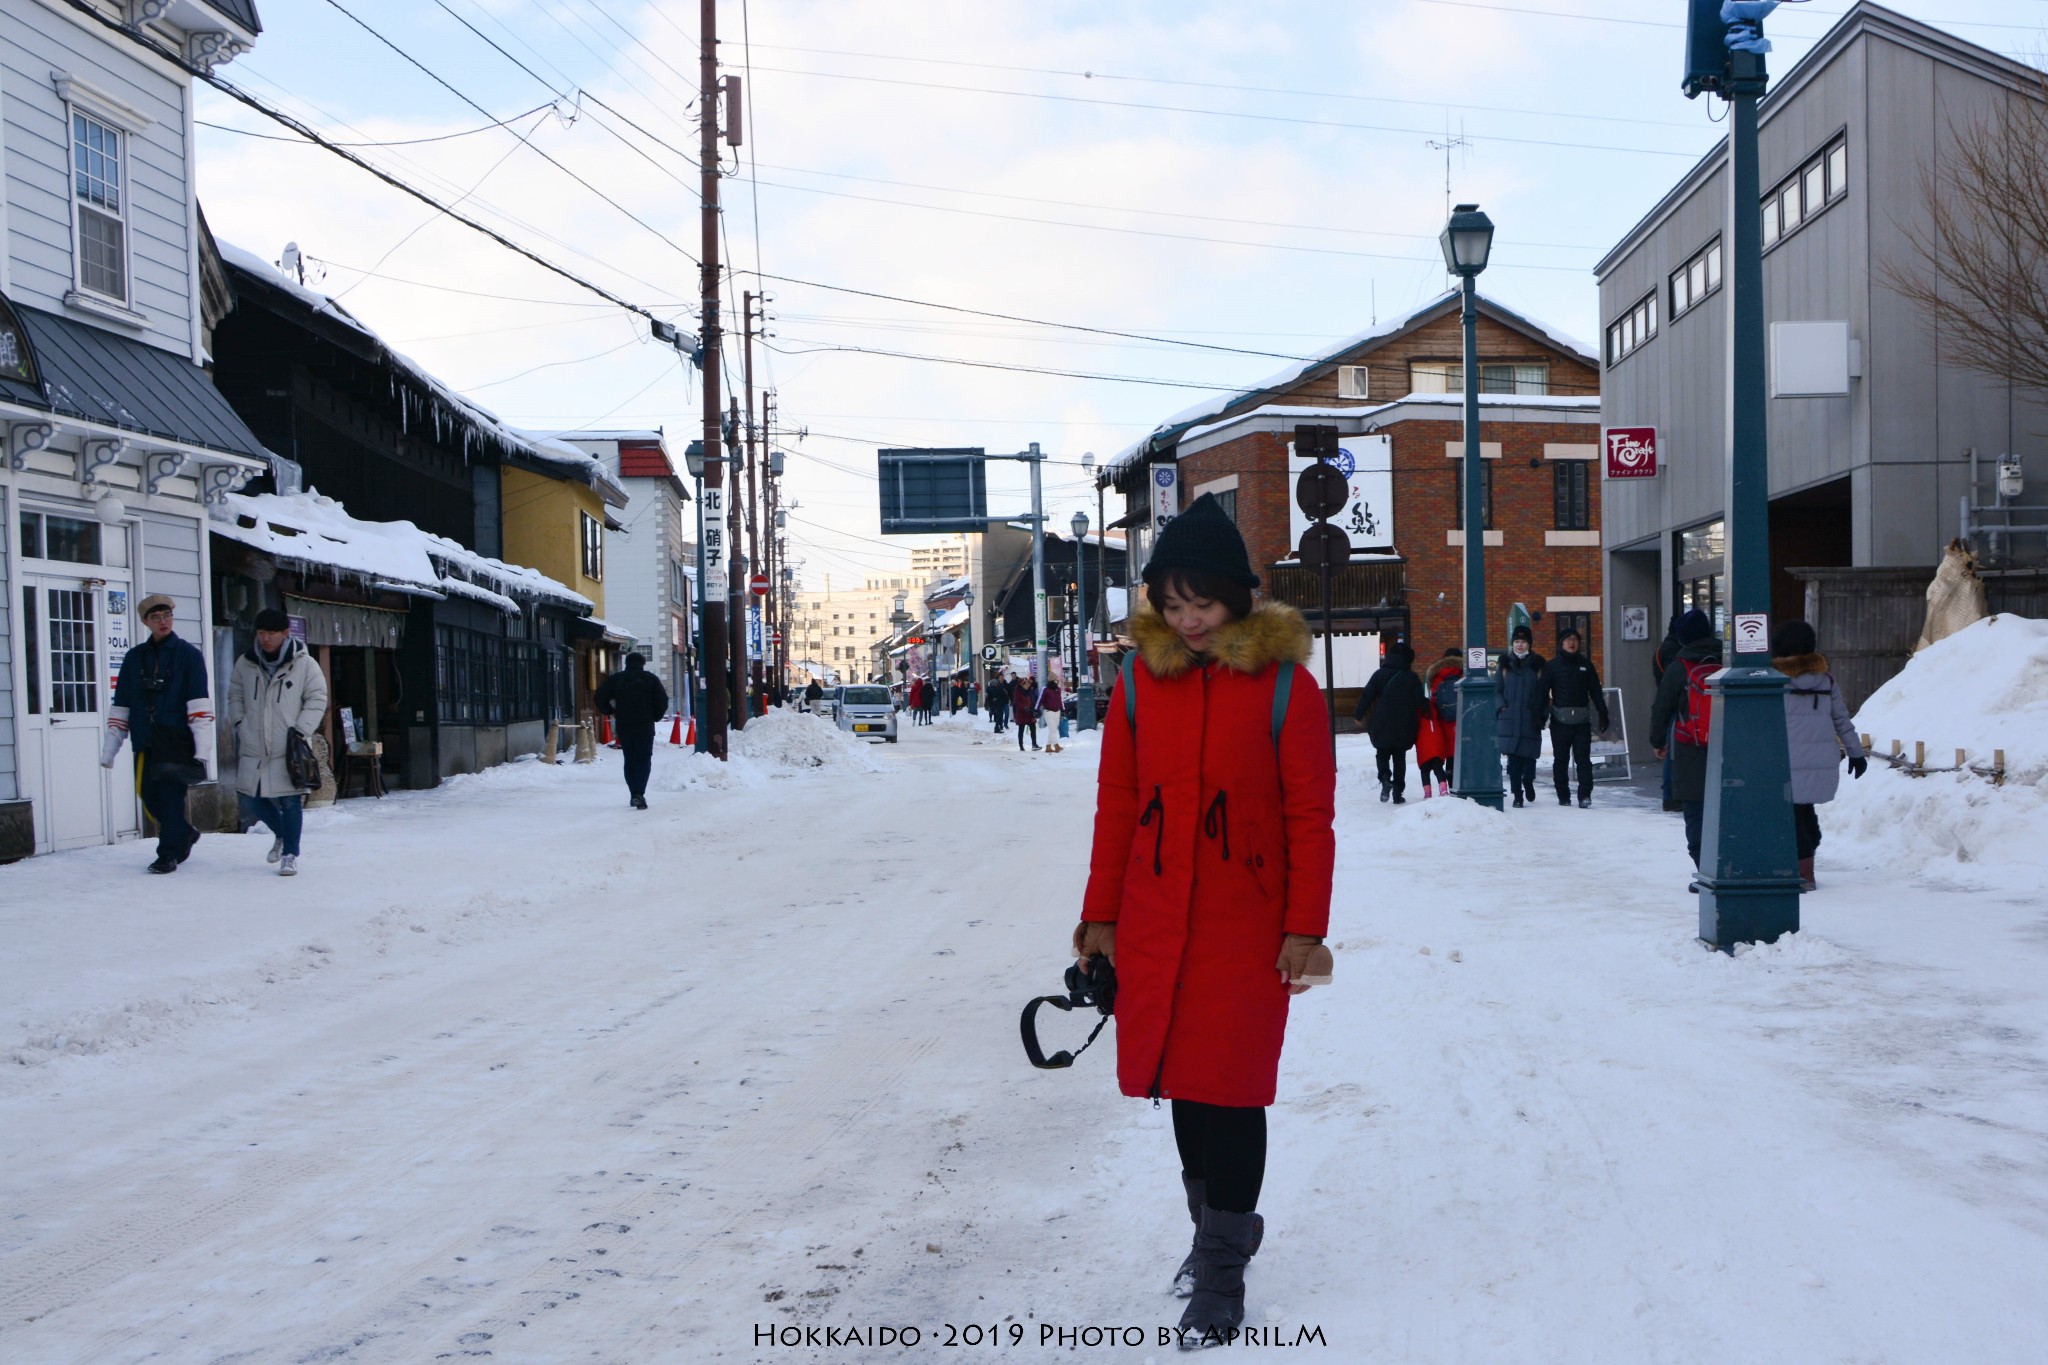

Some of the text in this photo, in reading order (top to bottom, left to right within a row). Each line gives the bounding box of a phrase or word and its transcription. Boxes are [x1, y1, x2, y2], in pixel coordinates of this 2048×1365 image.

[705, 491, 721, 567] 北一硝子
[985, 647, 995, 659] P
